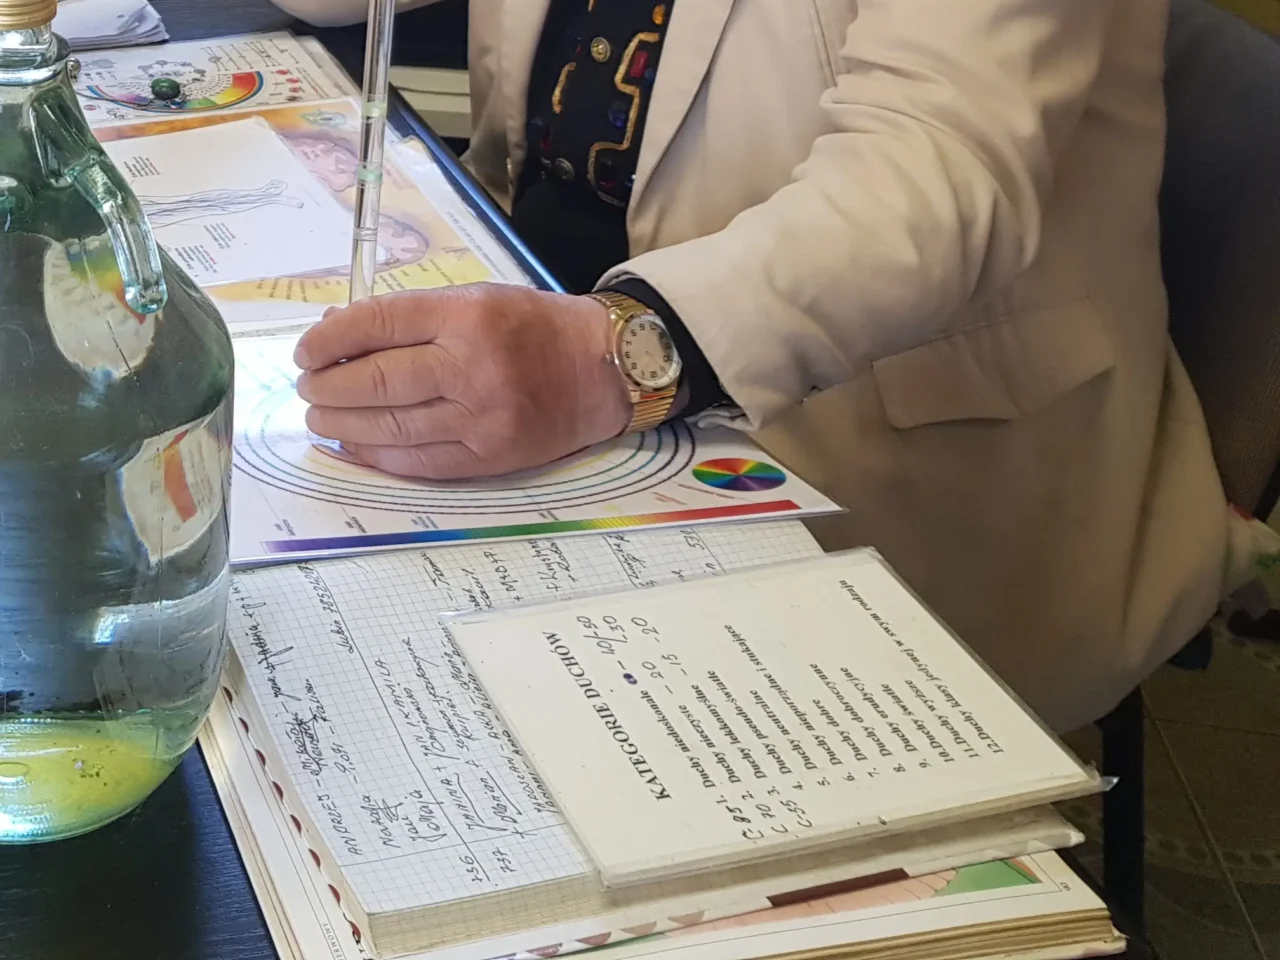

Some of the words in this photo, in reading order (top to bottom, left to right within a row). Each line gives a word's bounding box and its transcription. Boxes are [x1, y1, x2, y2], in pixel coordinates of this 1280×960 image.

[838, 579, 873, 612] rodzaju
[869, 612, 898, 638] swym
[723, 624, 764, 667] stukające
[892, 638, 905, 648] w
[541, 631, 603, 700] DUCHÓW
[899, 648, 942, 682] jedynej
[763, 673, 817, 732] nieporządne
[808, 663, 865, 724] dobroczynne
[839, 667, 889, 720] erudycyjne
[904, 679, 937, 713] wyższe
[934, 683, 963, 709] klasy
[678, 704, 717, 749] nieczyste
[690, 684, 742, 745] lekkomyślne
[749, 689, 792, 736] neutralne
[811, 699, 841, 728] dobre
[591, 702, 673, 802] KATEGORIE
[811, 733, 844, 767] Duchy
[836, 729, 869, 762] Duchy
[860, 725, 894, 758] Duchy
[885, 721, 920, 753] Duchy
[711, 751, 743, 784] Duchy
[736, 746, 769, 780] Duchy
[761, 742, 794, 775] Duchy
[786, 738, 820, 771] Duchy
[892, 762, 907, 773] 8.
[918, 758, 933, 769] 9.
[685, 755, 717, 789] Duchy
[791, 780, 804, 791] 4.
[816, 776, 831, 787] 5.
[841, 771, 856, 782] 6.
[866, 767, 881, 778] 7.
[715, 794, 729, 805] 1.
[741, 789, 755, 801] 2.
[766, 785, 781, 797] 3.
